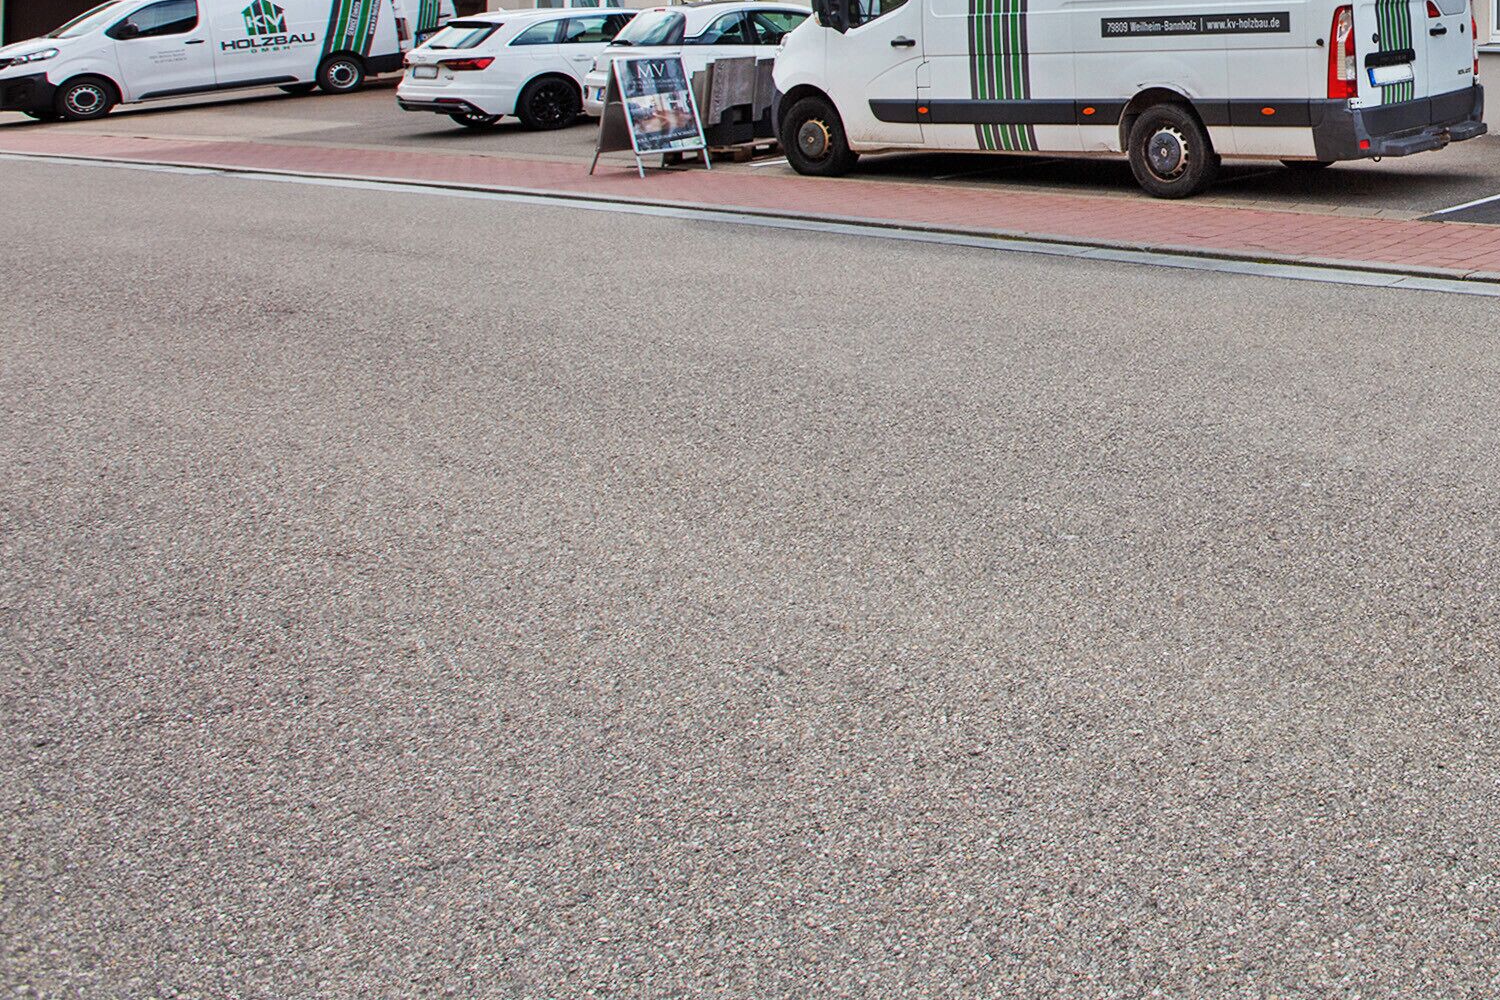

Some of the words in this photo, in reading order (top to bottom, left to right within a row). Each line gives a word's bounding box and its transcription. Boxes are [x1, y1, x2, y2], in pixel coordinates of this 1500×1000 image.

[247, 12, 284, 29] KV
[1106, 22, 1128, 33] 79809
[1130, 19, 1197, 32] Weilheim-Bannholz
[1206, 16, 1280, 30] www.kv-holzbau.de
[220, 32, 316, 51] HOLZBAU
[636, 62, 665, 79] MV
